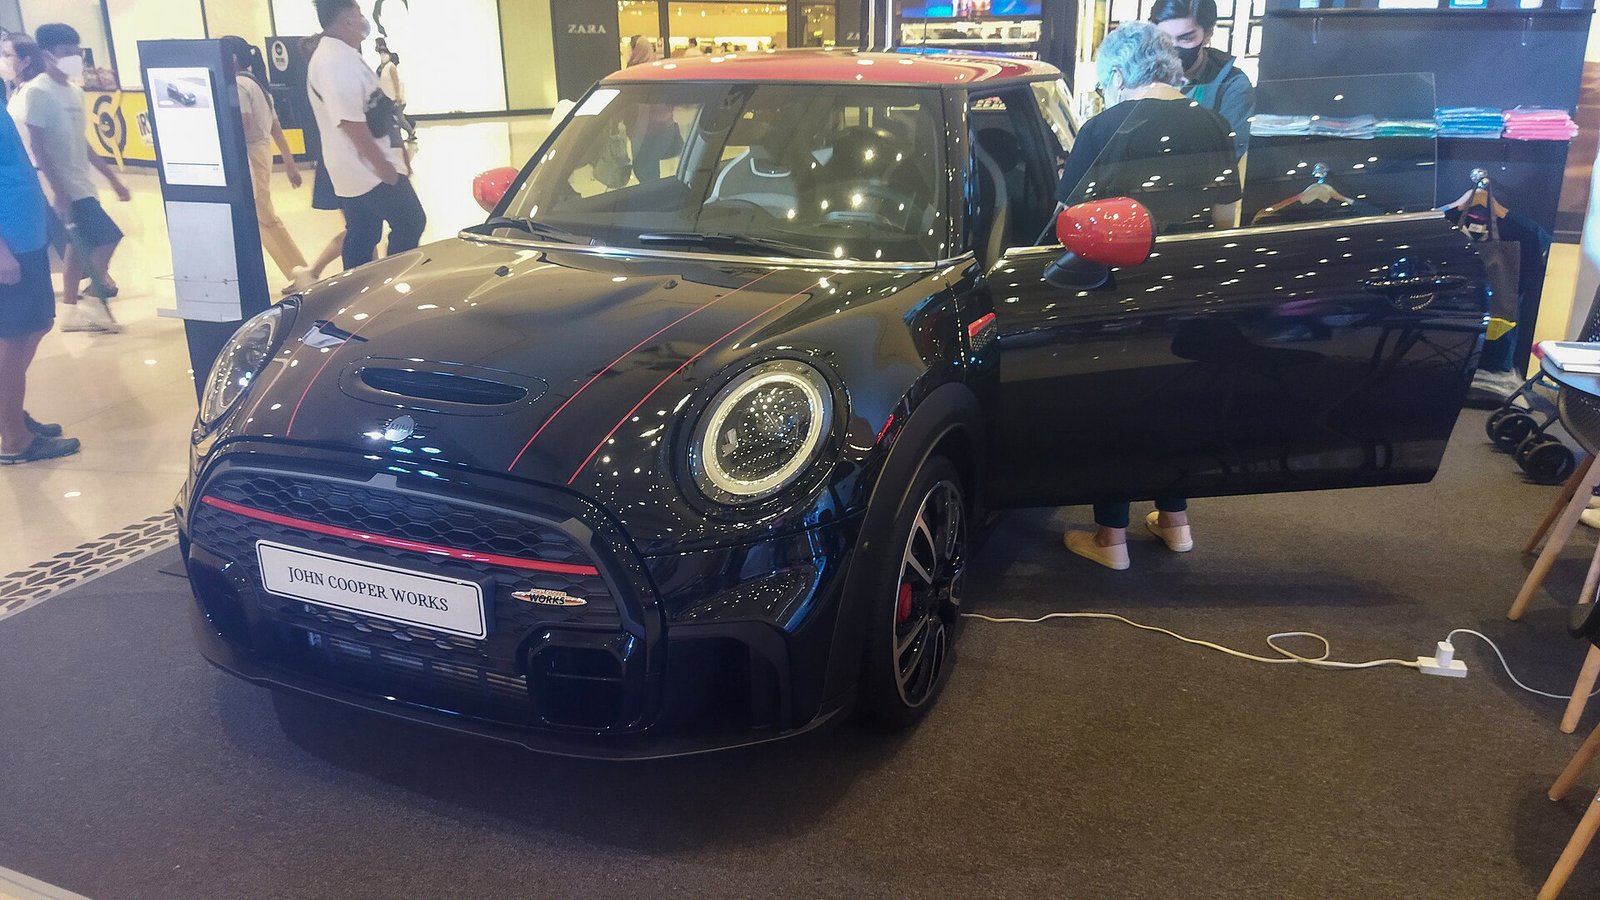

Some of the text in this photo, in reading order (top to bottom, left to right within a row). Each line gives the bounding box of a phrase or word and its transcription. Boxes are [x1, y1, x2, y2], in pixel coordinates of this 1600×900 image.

[568, 24, 607, 34] ZARA
[288, 566, 449, 612] JOHN COOPER WORKS
[528, 593, 565, 605] WORKS
